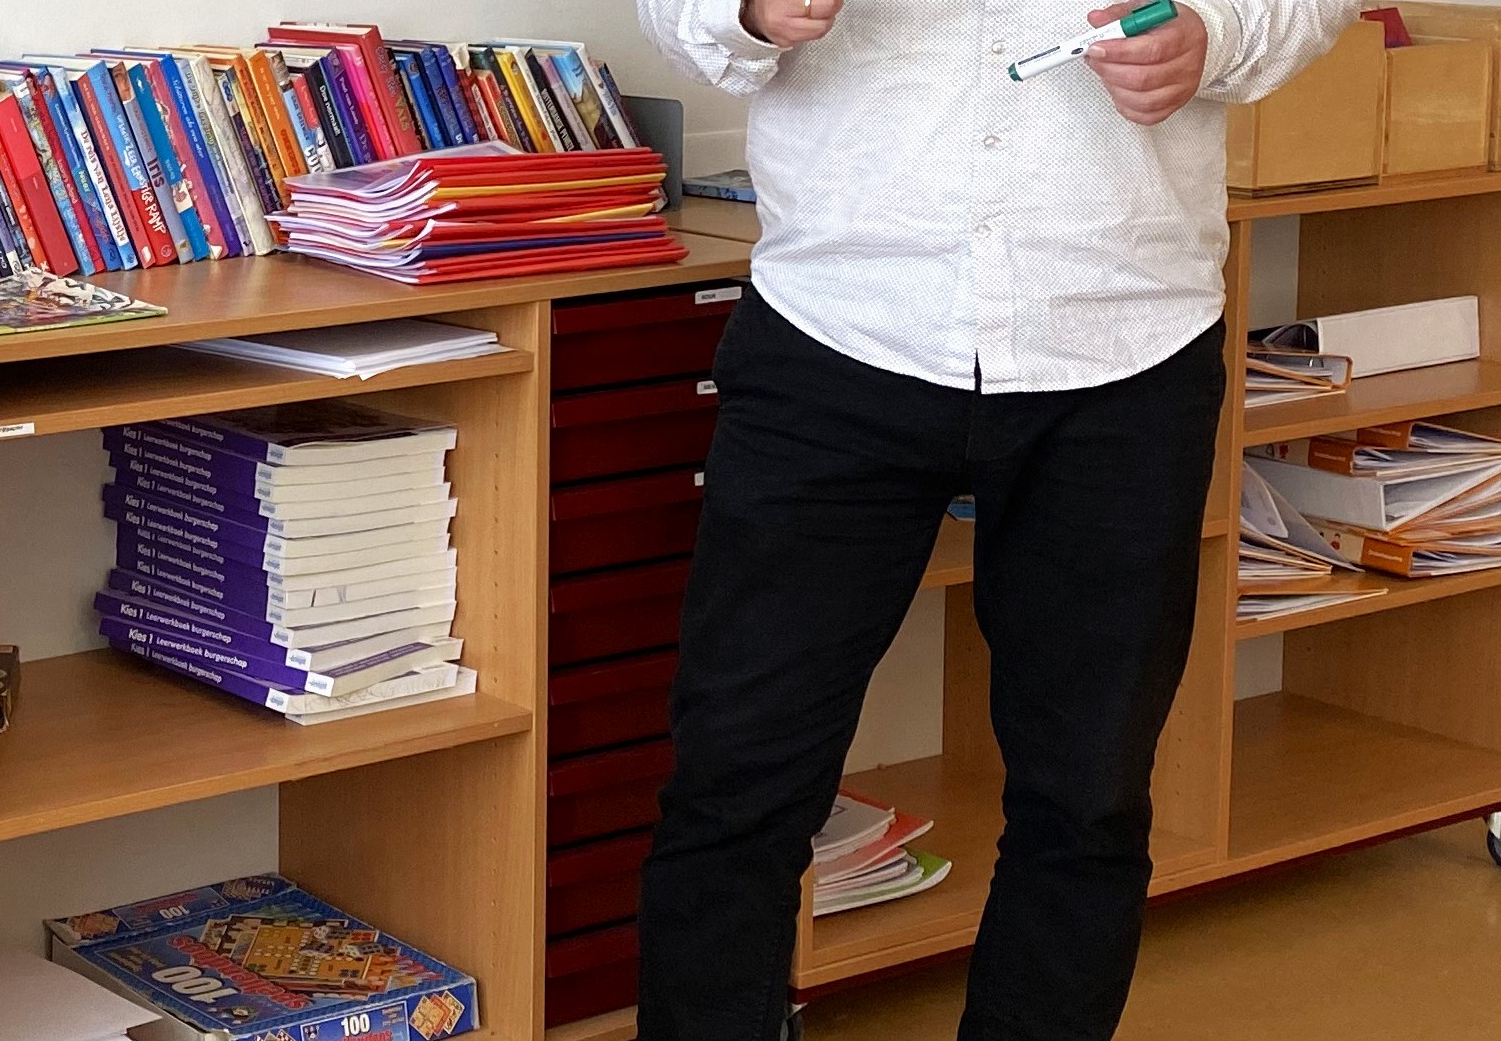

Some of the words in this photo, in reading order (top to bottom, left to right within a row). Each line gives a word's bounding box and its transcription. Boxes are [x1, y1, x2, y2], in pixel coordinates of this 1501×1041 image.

[318, 85, 330, 102] Doe
[392, 96, 413, 132] VALS
[80, 130, 92, 144] De
[145, 156, 168, 189] Iris
[143, 203, 168, 237] RAMP
[137, 543, 151, 557] Kies
[137, 560, 150, 574] Kies
[156, 568, 191, 587] Leerwerkboek
[192, 581, 224, 600] burgerschap
[131, 580, 146, 594] Kies
[153, 589, 190, 607] Leerwerkboek
[190, 601, 226, 621] burgerschap
[120, 604, 137, 618] Kies
[146, 612, 190, 631] Leerwerkboek
[191, 624, 232, 644] burgerschap
[128, 628, 147, 643] Kies
[156, 636, 203, 656] Leerwerkboek
[204, 649, 248, 669] burgerschap
[130, 643, 145, 656] Kies
[151, 650, 188, 670] Leerwerkboek
[188, 663, 222, 683] burgerschap
[159, 904, 190, 920] 100
[152, 966, 240, 1004] 100
[340, 1014, 370, 1036] 100
